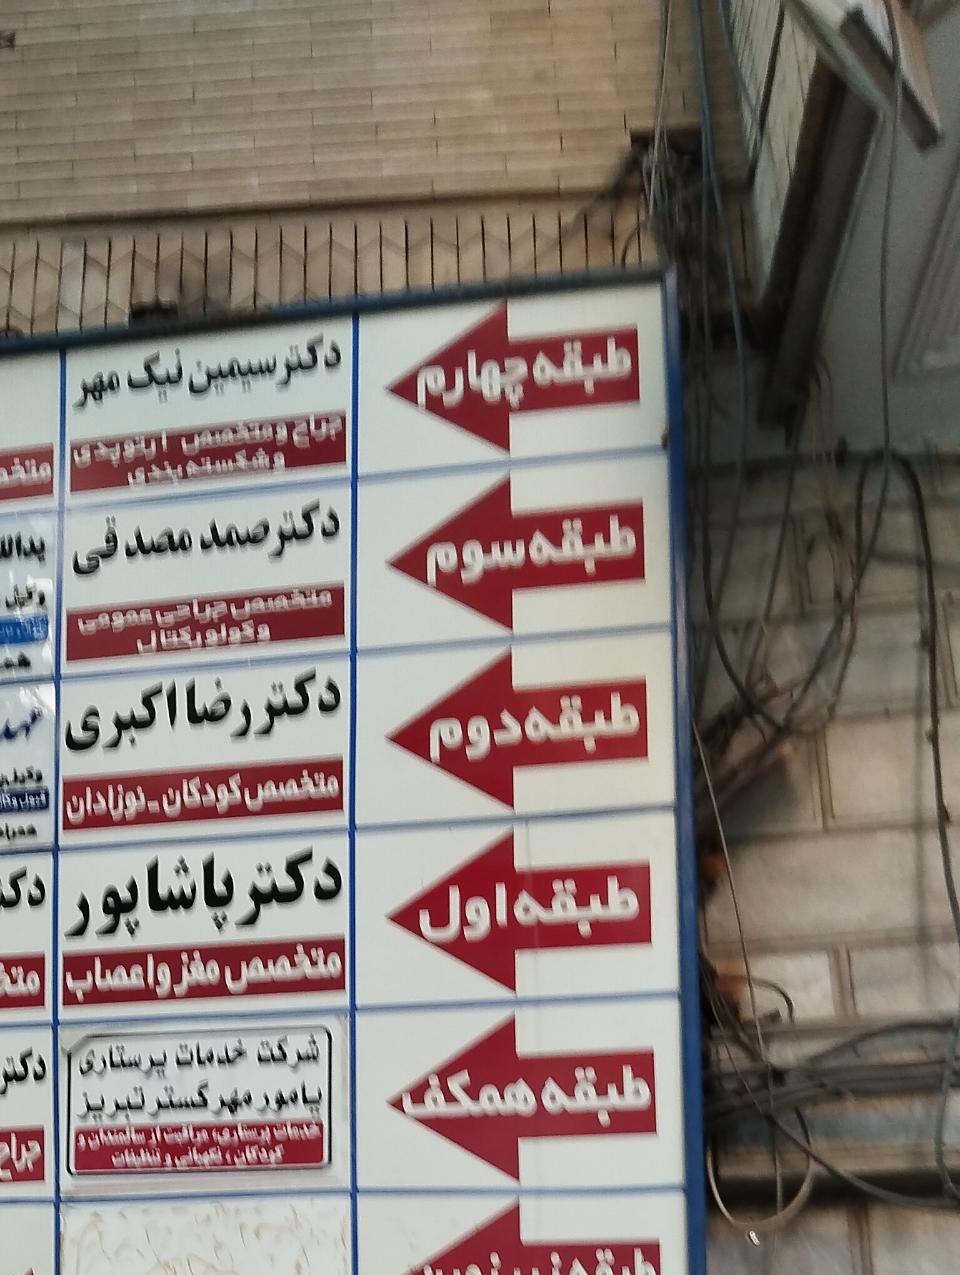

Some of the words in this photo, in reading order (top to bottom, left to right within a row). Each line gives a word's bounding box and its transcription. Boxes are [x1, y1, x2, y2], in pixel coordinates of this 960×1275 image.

[127, 348, 183, 402] نیک
[189, 355, 277, 395] سیمین
[276, 333, 341, 386] دکتر
[417, 351, 527, 409] چهارم
[532, 337, 631, 396] طبقه
[72, 370, 121, 408] مهر
[73, 515, 192, 575] مصدقی
[200, 518, 270, 550] صمد
[268, 499, 340, 558] دکتر
[528, 515, 636, 576] طبقه
[427, 538, 525, 587] سوم
[65, 680, 176, 751] اکبری
[186, 677, 251, 737] رضا
[254, 667, 340, 735] دکتر
[524, 691, 639, 753] طبقه
[430, 708, 522, 763] دوم
[66, 784, 146, 824] نوزادان
[162, 773, 241, 818] کودکان
[244, 769, 339, 812] متخصص
[64, 851, 234, 937] پاشاپور
[235, 845, 341, 925] دکتر
[513, 876, 639, 938] طبقه
[419, 881, 508, 943] اول
[66, 952, 154, 1003] اعصاب
[174, 950, 219, 997] مغز
[225, 943, 341, 993] متخصص
[79, 1044, 167, 1080] پرستاری
[176, 1038, 247, 1067] خدمات
[257, 1033, 319, 1068] شرکت
[77, 1086, 145, 1124] تبریز
[147, 1080, 209, 1116] گستر
[401, 1070, 537, 1121] همکف
[541, 1065, 651, 1127] طبقه
